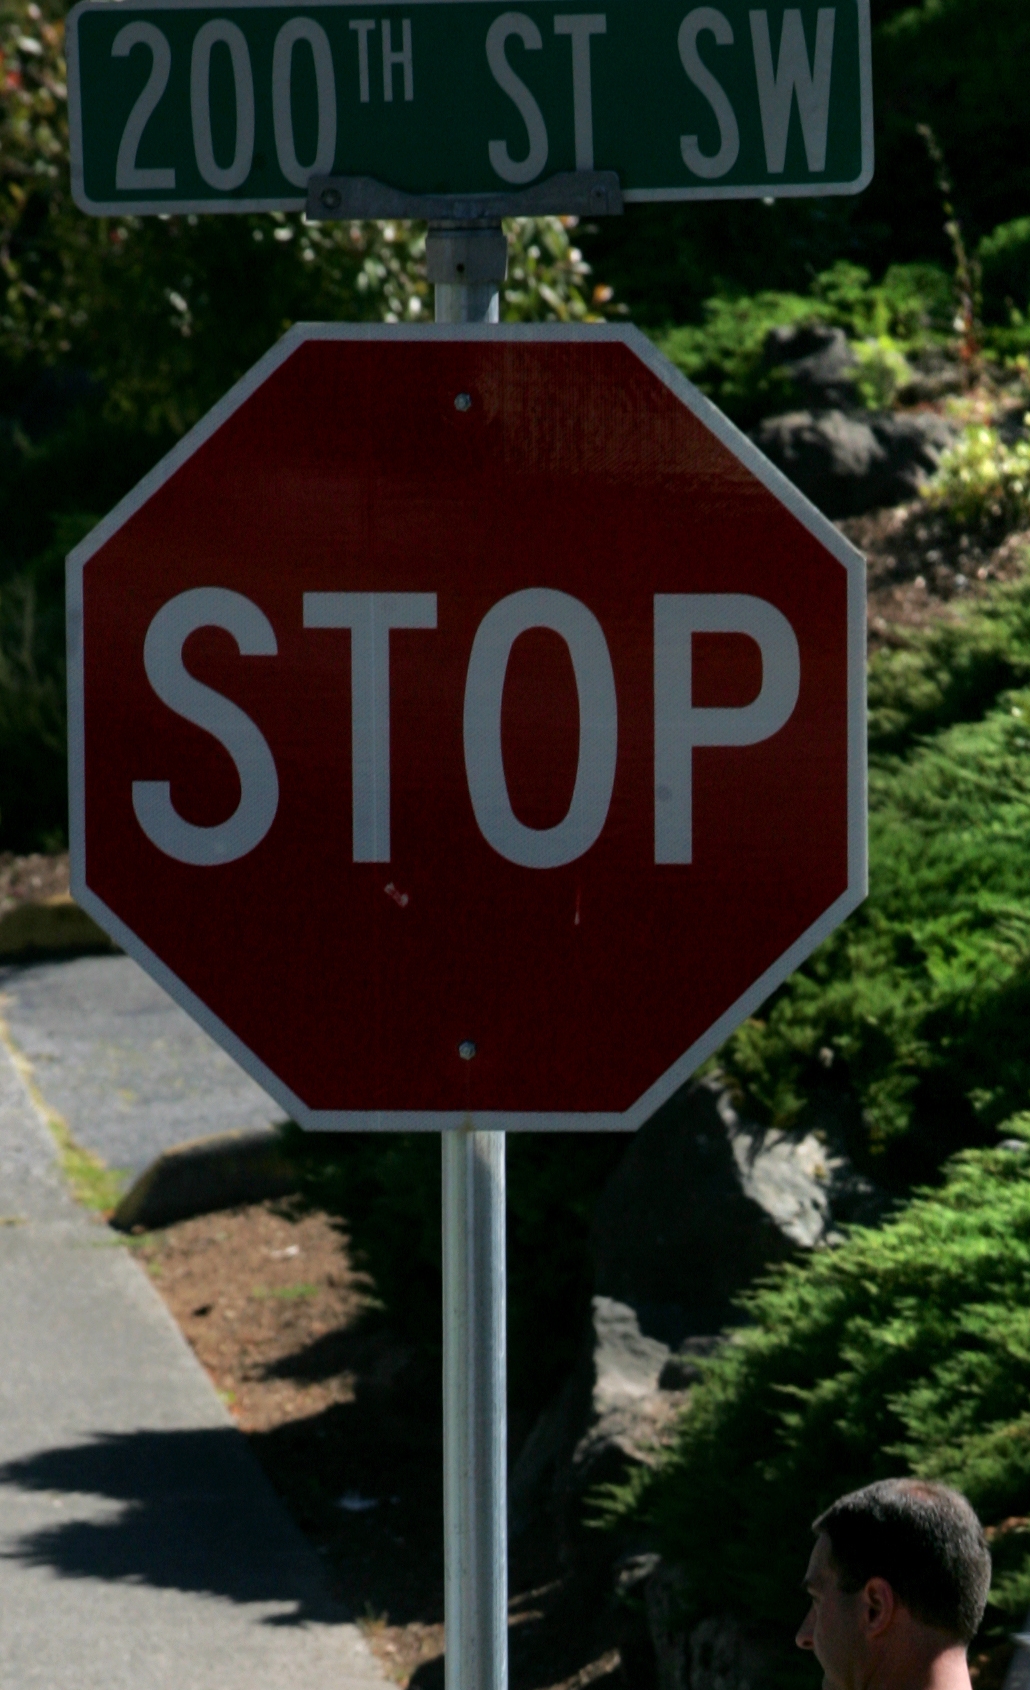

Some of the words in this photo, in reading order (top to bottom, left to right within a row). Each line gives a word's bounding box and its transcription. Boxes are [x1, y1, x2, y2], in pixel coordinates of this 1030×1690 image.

[485, 11, 607, 184] ST
[677, 7, 838, 178] SW
[131, 586, 801, 869] STOP
